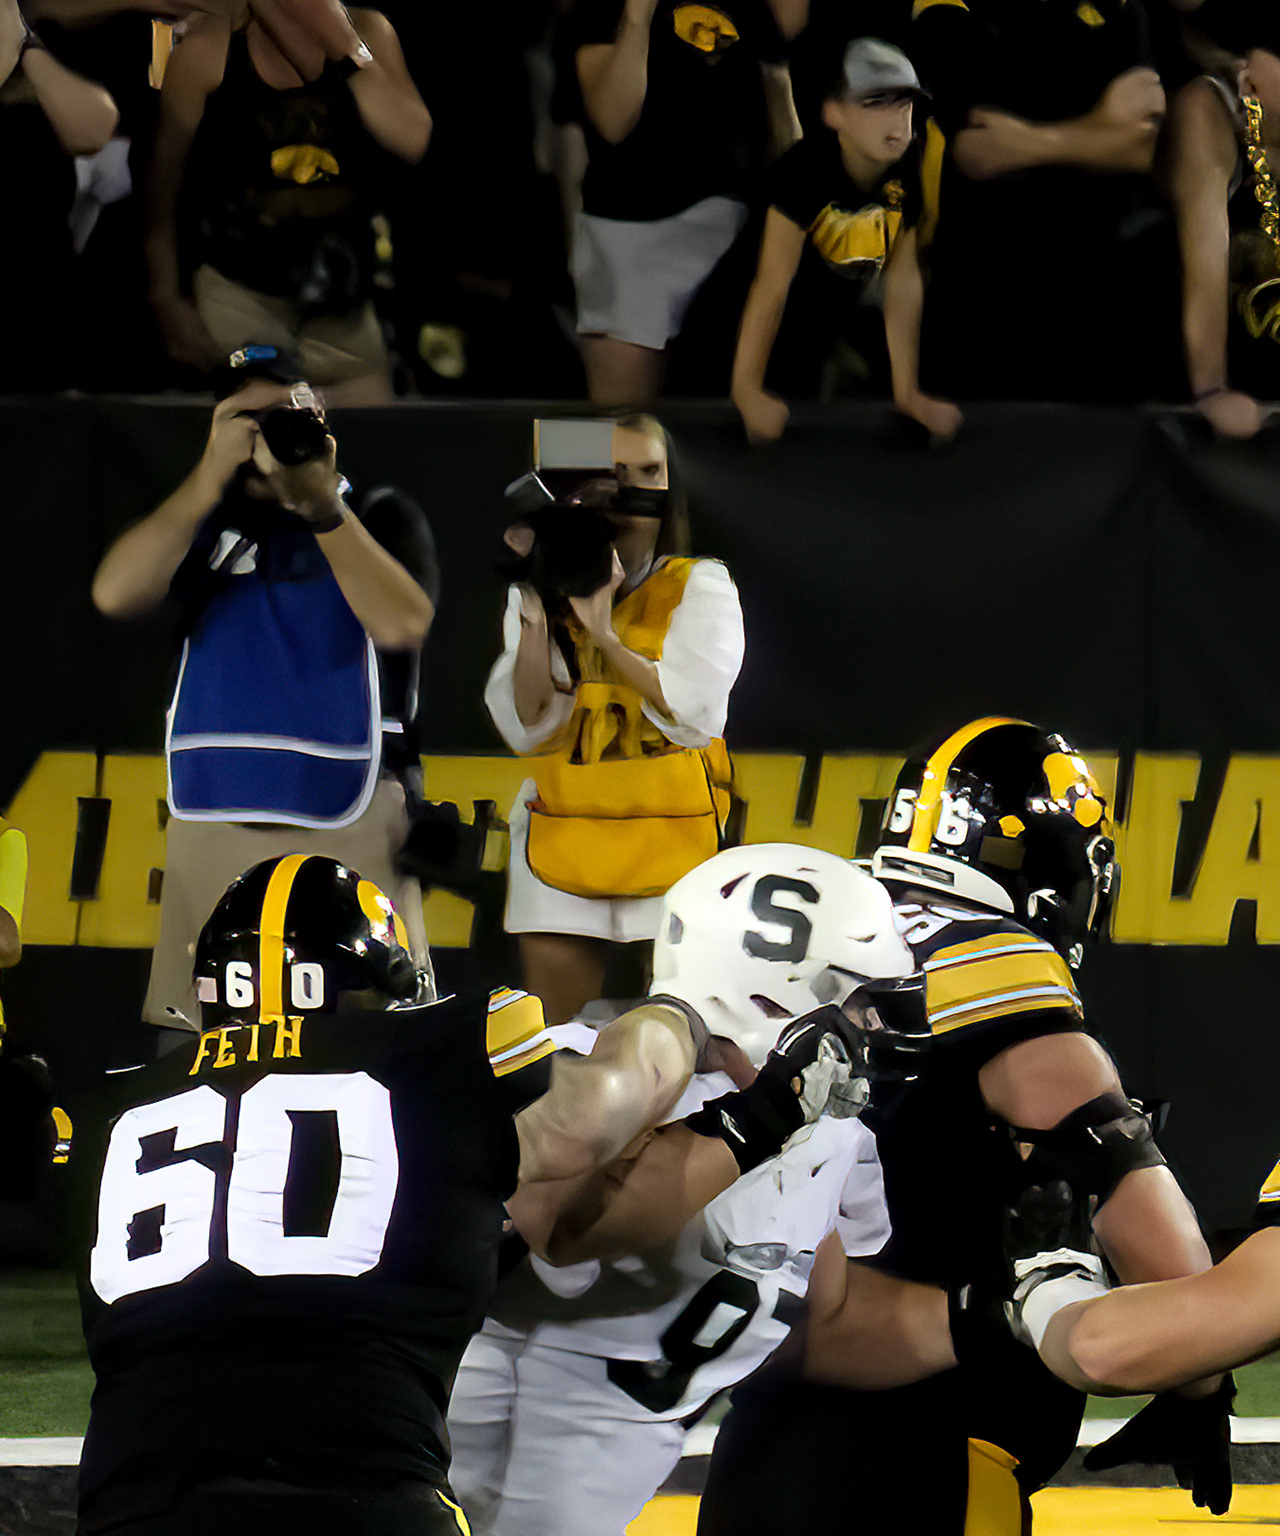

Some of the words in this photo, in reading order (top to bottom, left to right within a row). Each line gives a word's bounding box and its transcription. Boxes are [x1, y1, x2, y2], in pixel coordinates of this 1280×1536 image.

[741, 873, 820, 964] S
[226, 960, 326, 1010] 60
[188, 1014, 305, 1077] FETH
[89, 1070, 402, 1306] 60
